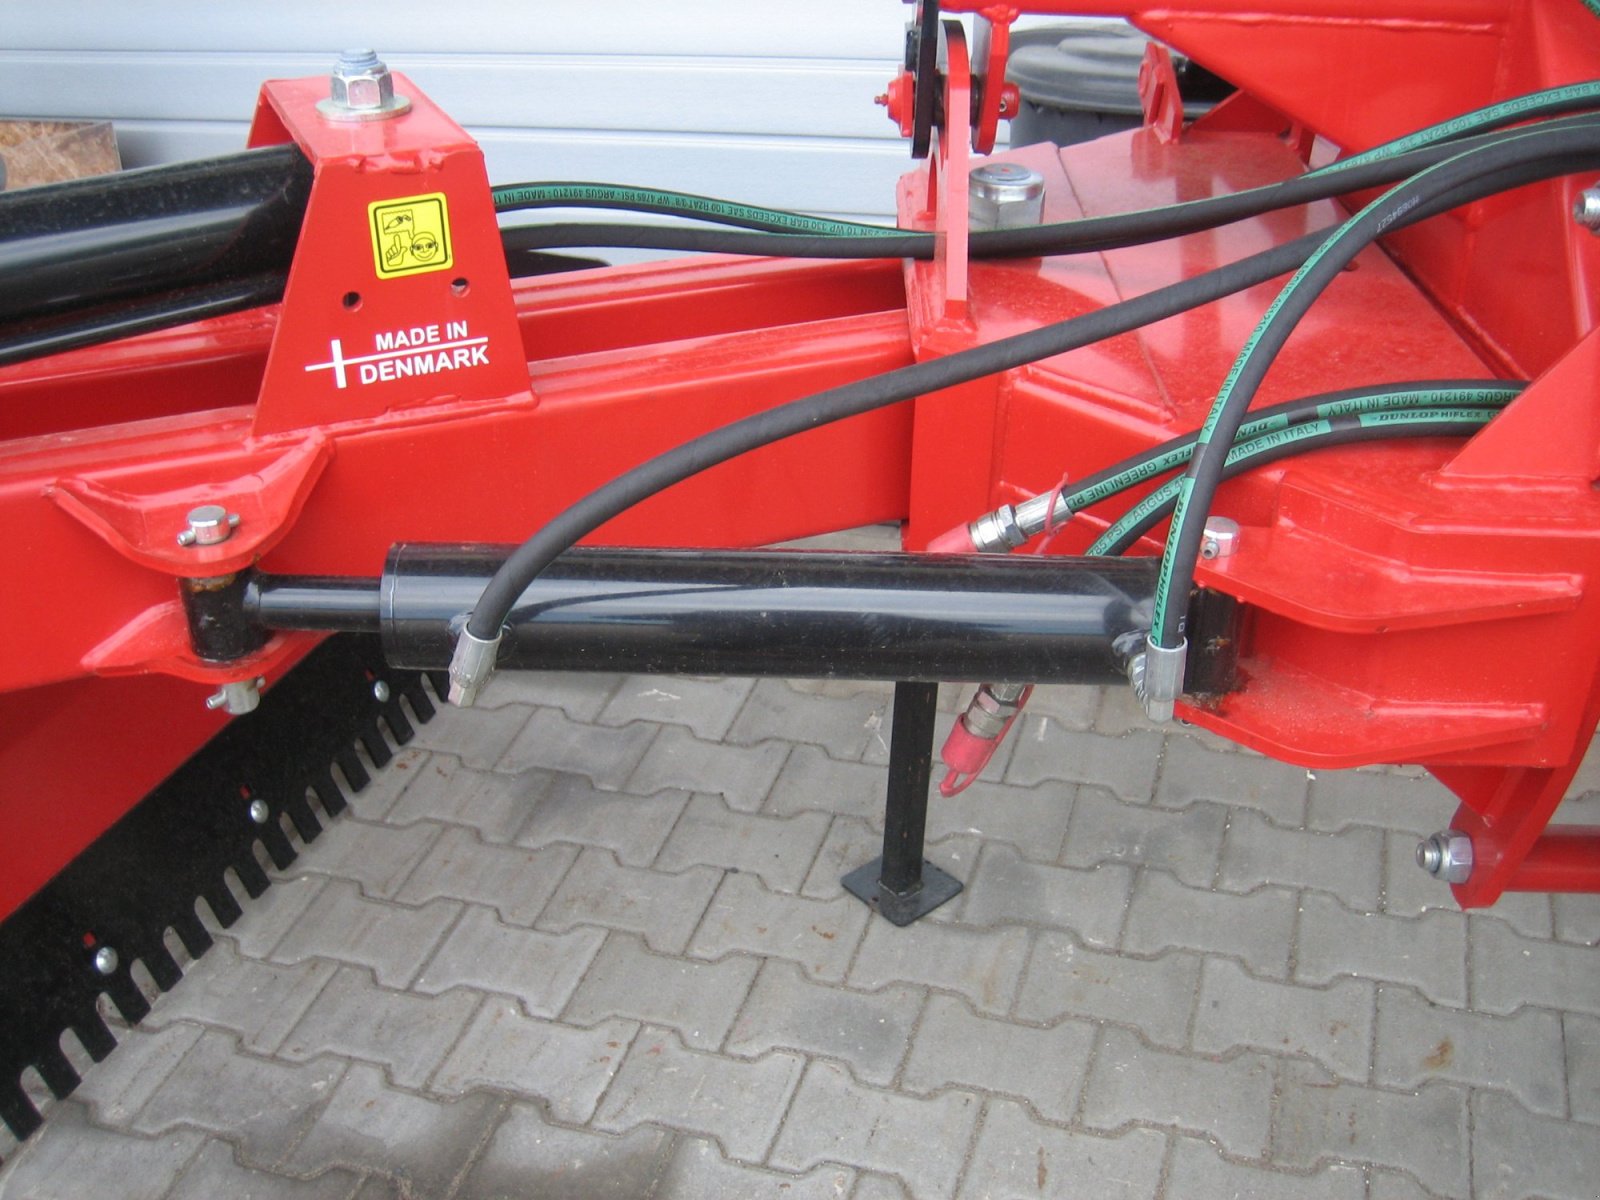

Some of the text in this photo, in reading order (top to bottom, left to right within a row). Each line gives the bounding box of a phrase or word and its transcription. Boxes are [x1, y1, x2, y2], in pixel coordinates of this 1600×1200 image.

[504, 192, 515, 204] IN
[518, 189, 546, 201] MADE
[553, 187, 584, 199] 491210
[585, 188, 615, 200] ARGUS
[657, 195, 670, 206] WP
[711, 203, 724, 214] 100
[728, 206, 745, 217] SAE
[747, 208, 788, 226] EXCEEDS
[790, 217, 809, 229] BAR
[376, 320, 468, 351] MADE IN
[359, 345, 490, 385] DENMARK
[1366, 396, 1380, 409] IN
[1383, 392, 1420, 406] MADE
[1430, 391, 1473, 403] 491210
[1327, 398, 1364, 416] ITALY
[1204, 395, 1225, 433] ITALY
[1379, 411, 1439, 422] DUNLOP
[1226, 422, 1319, 461] MADE IN ITALY
[1086, 461, 1157, 502] GREENLINE
[1106, 522, 1126, 542] PSI
[1132, 486, 1173, 522] ARGUS
[1161, 499, 1185, 578] DUNLOP
[1152, 578, 1167, 631] HIFLEX
